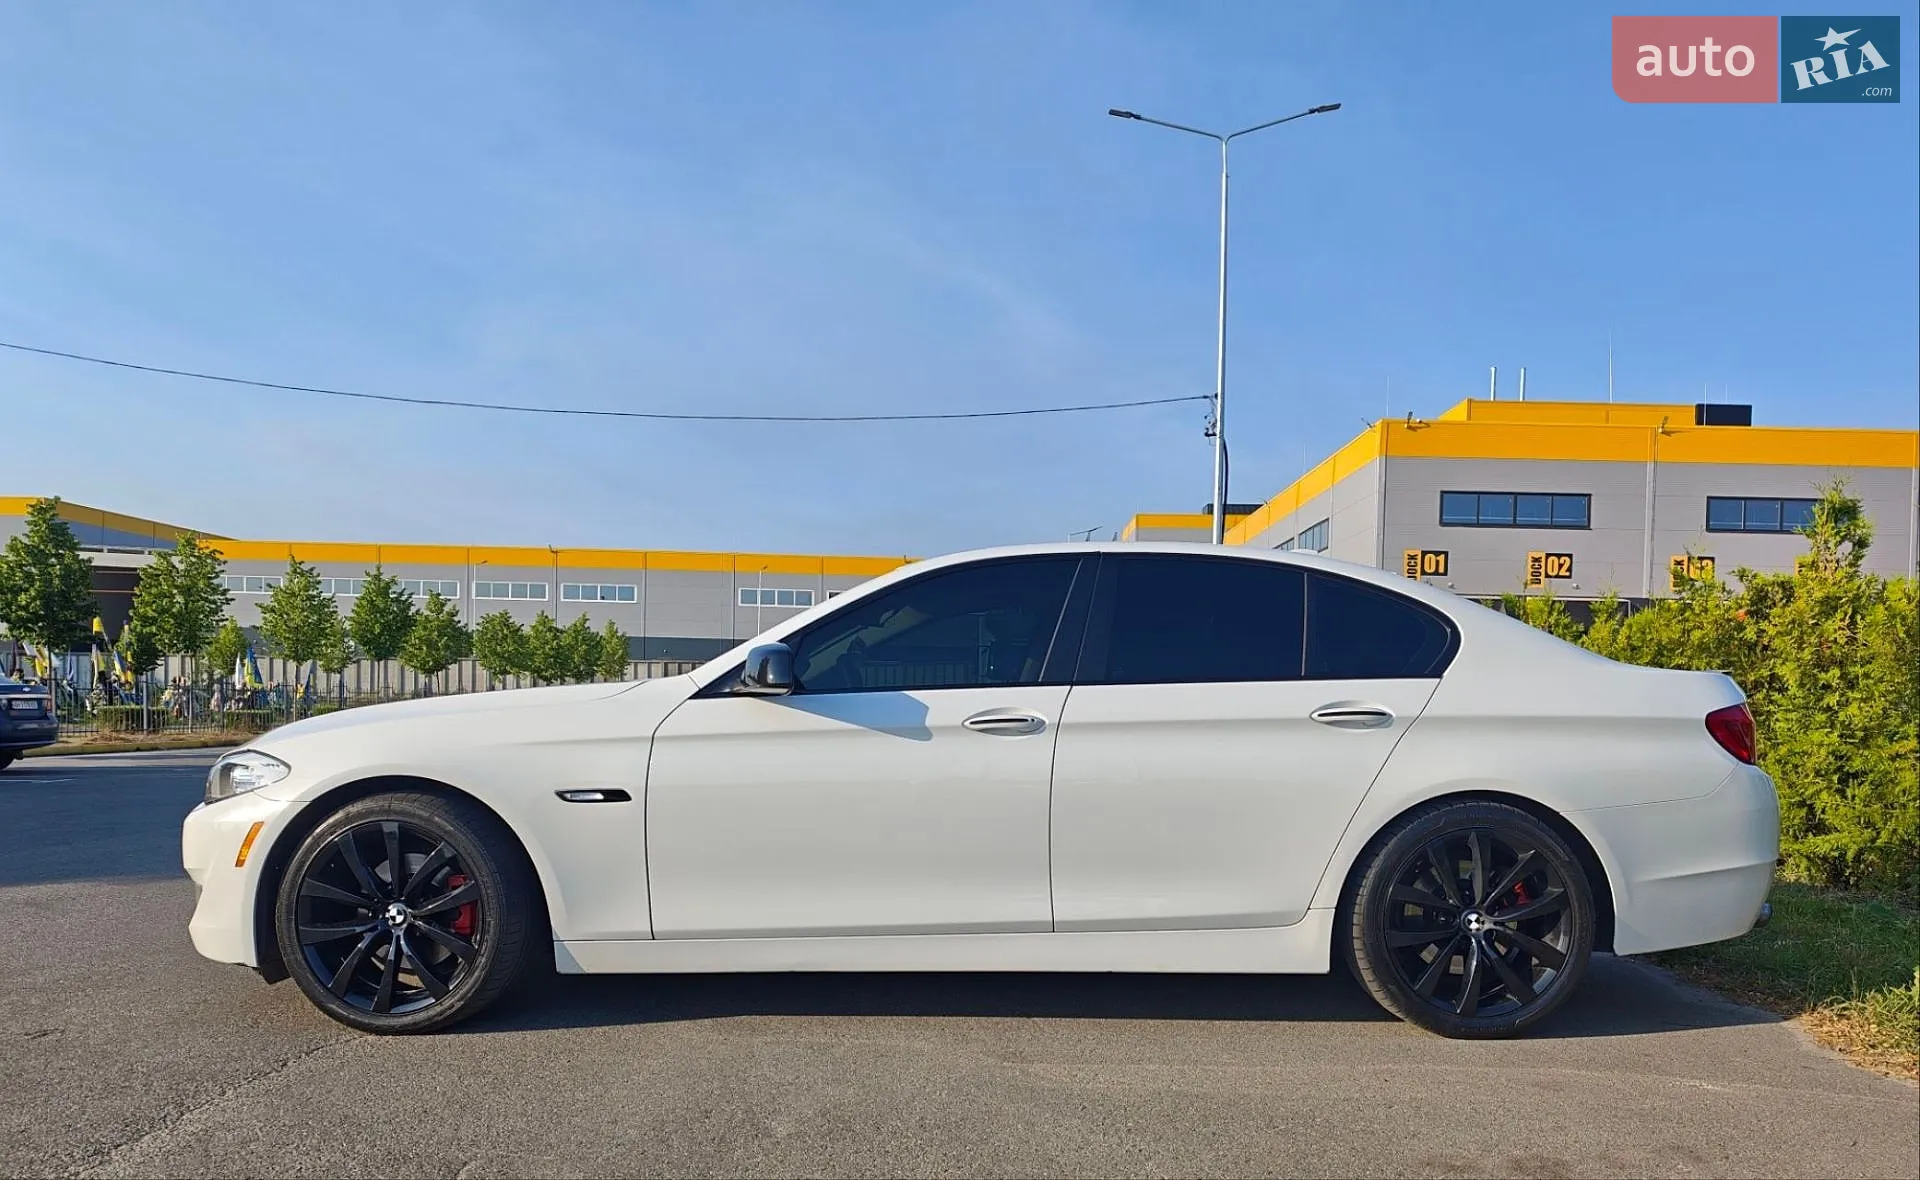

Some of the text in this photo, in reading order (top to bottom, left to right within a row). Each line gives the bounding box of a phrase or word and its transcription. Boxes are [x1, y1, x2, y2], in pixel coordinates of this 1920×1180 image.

[1424, 553, 1445, 573] 01
[1531, 556, 1542, 585] DOCK
[1547, 556, 1571, 576] 02
